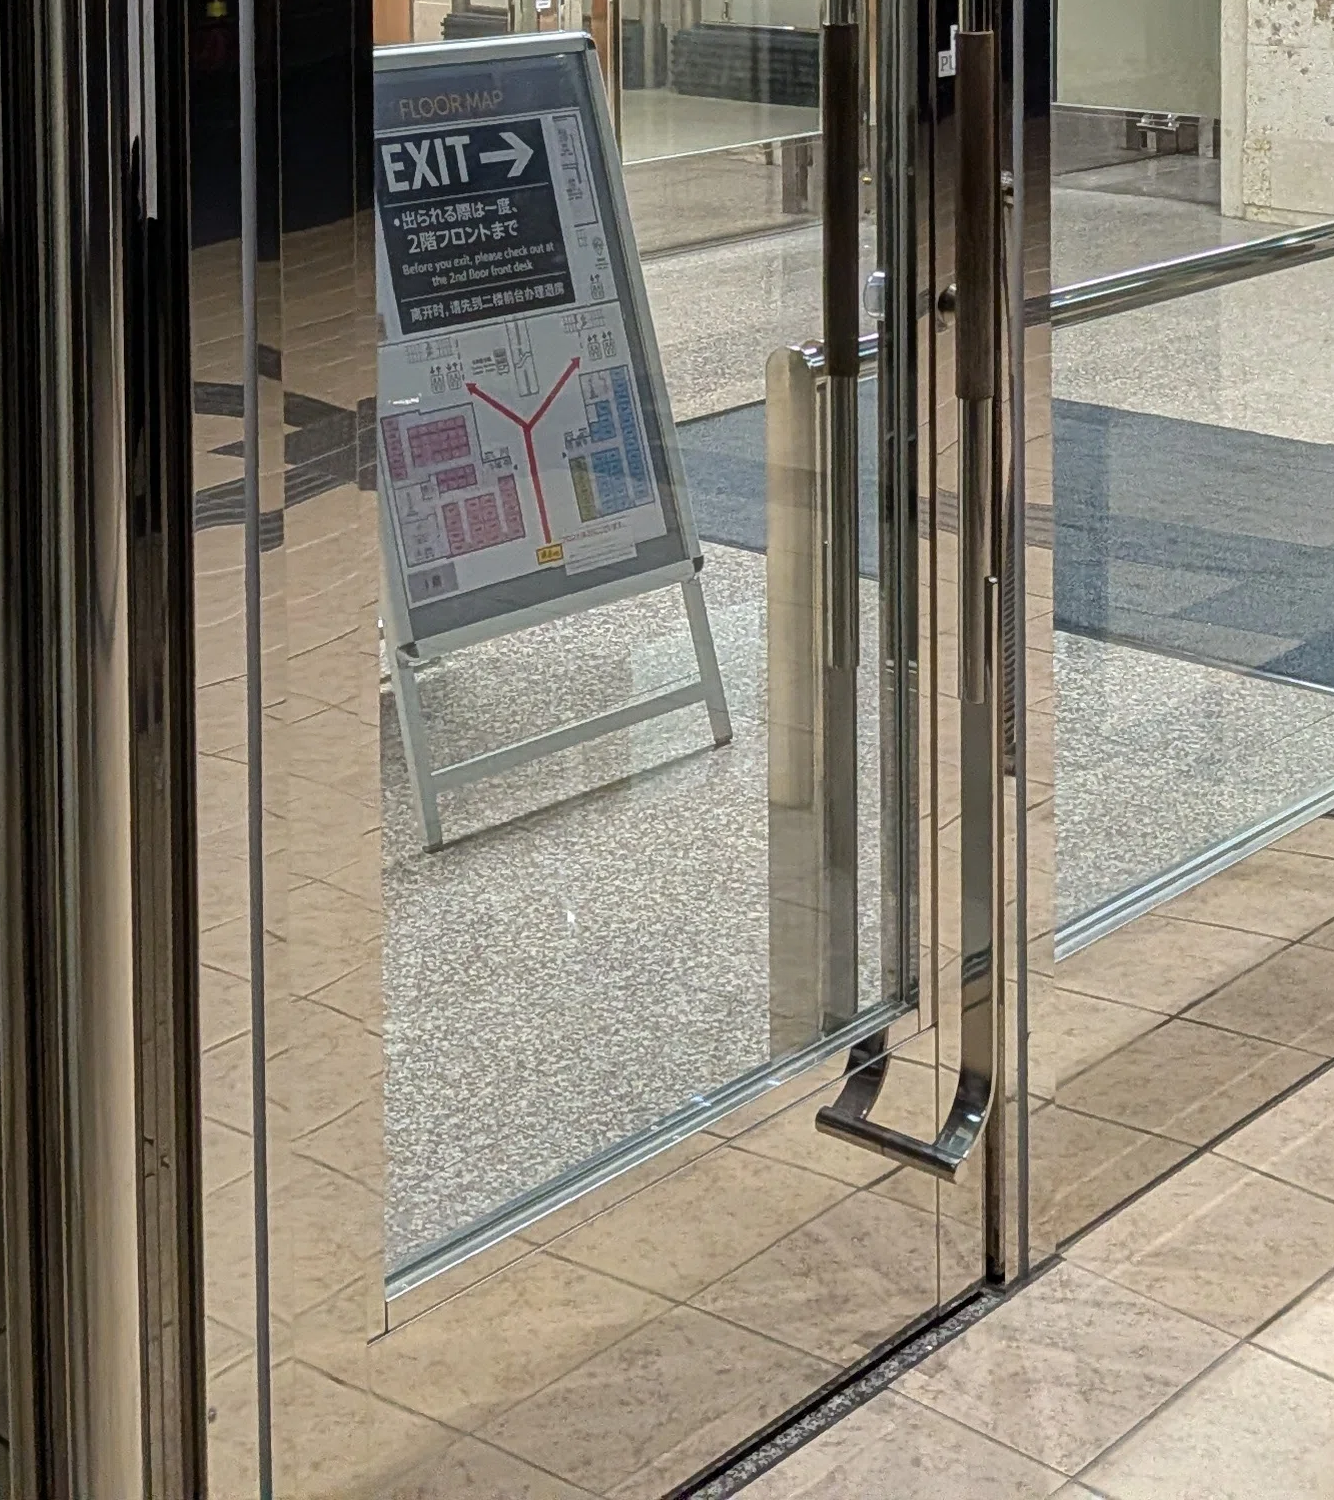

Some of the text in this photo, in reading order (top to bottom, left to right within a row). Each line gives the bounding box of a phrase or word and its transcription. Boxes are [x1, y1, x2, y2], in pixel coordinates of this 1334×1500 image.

[399, 90, 503, 119] FLOOR MAP
[381, 135, 470, 193] EXIT
[407, 219, 519, 253] 2階フロントまで
[402, 259, 433, 275] Before
[435, 259, 452, 272] you
[474, 250, 503, 265] please
[504, 245, 529, 260] check
[530, 243, 545, 255] out
[545, 241, 555, 252] at
[432, 258, 534, 287] the 2nd floor front desk
